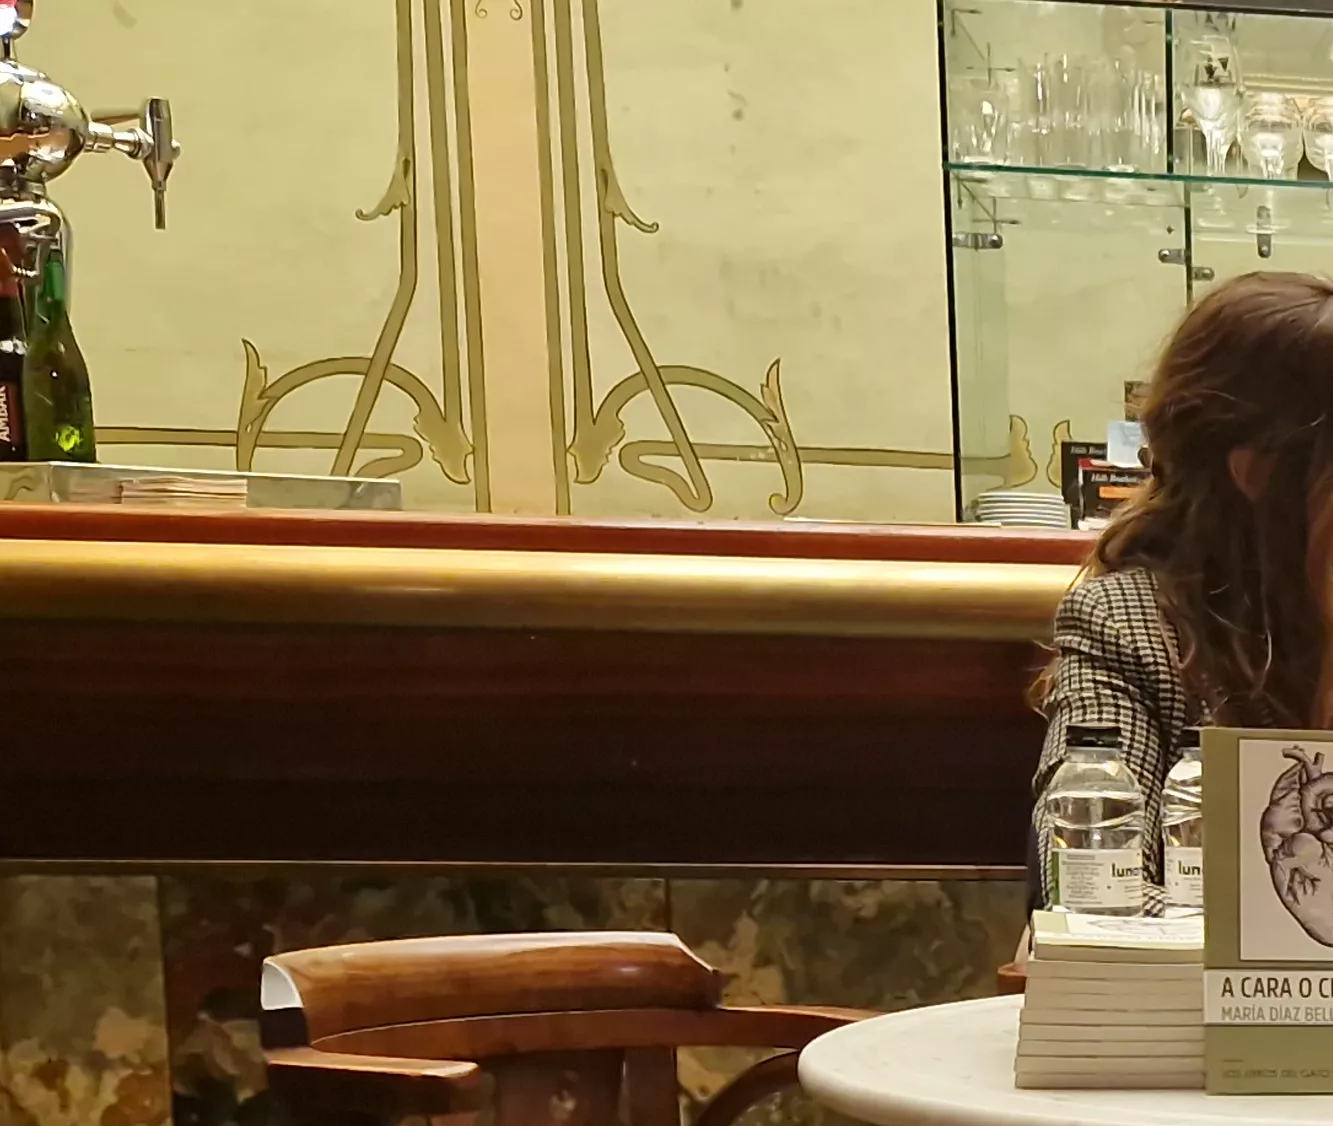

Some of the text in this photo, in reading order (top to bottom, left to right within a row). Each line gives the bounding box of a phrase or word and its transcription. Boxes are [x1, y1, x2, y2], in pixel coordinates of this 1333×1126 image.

[1221, 977, 1234, 998] A
[1241, 977, 1292, 998] CARA
[1300, 977, 1312, 998] O
[1221, 1004, 1265, 1021] MARÍA
[1269, 1004, 1300, 1021] DÍAZ
